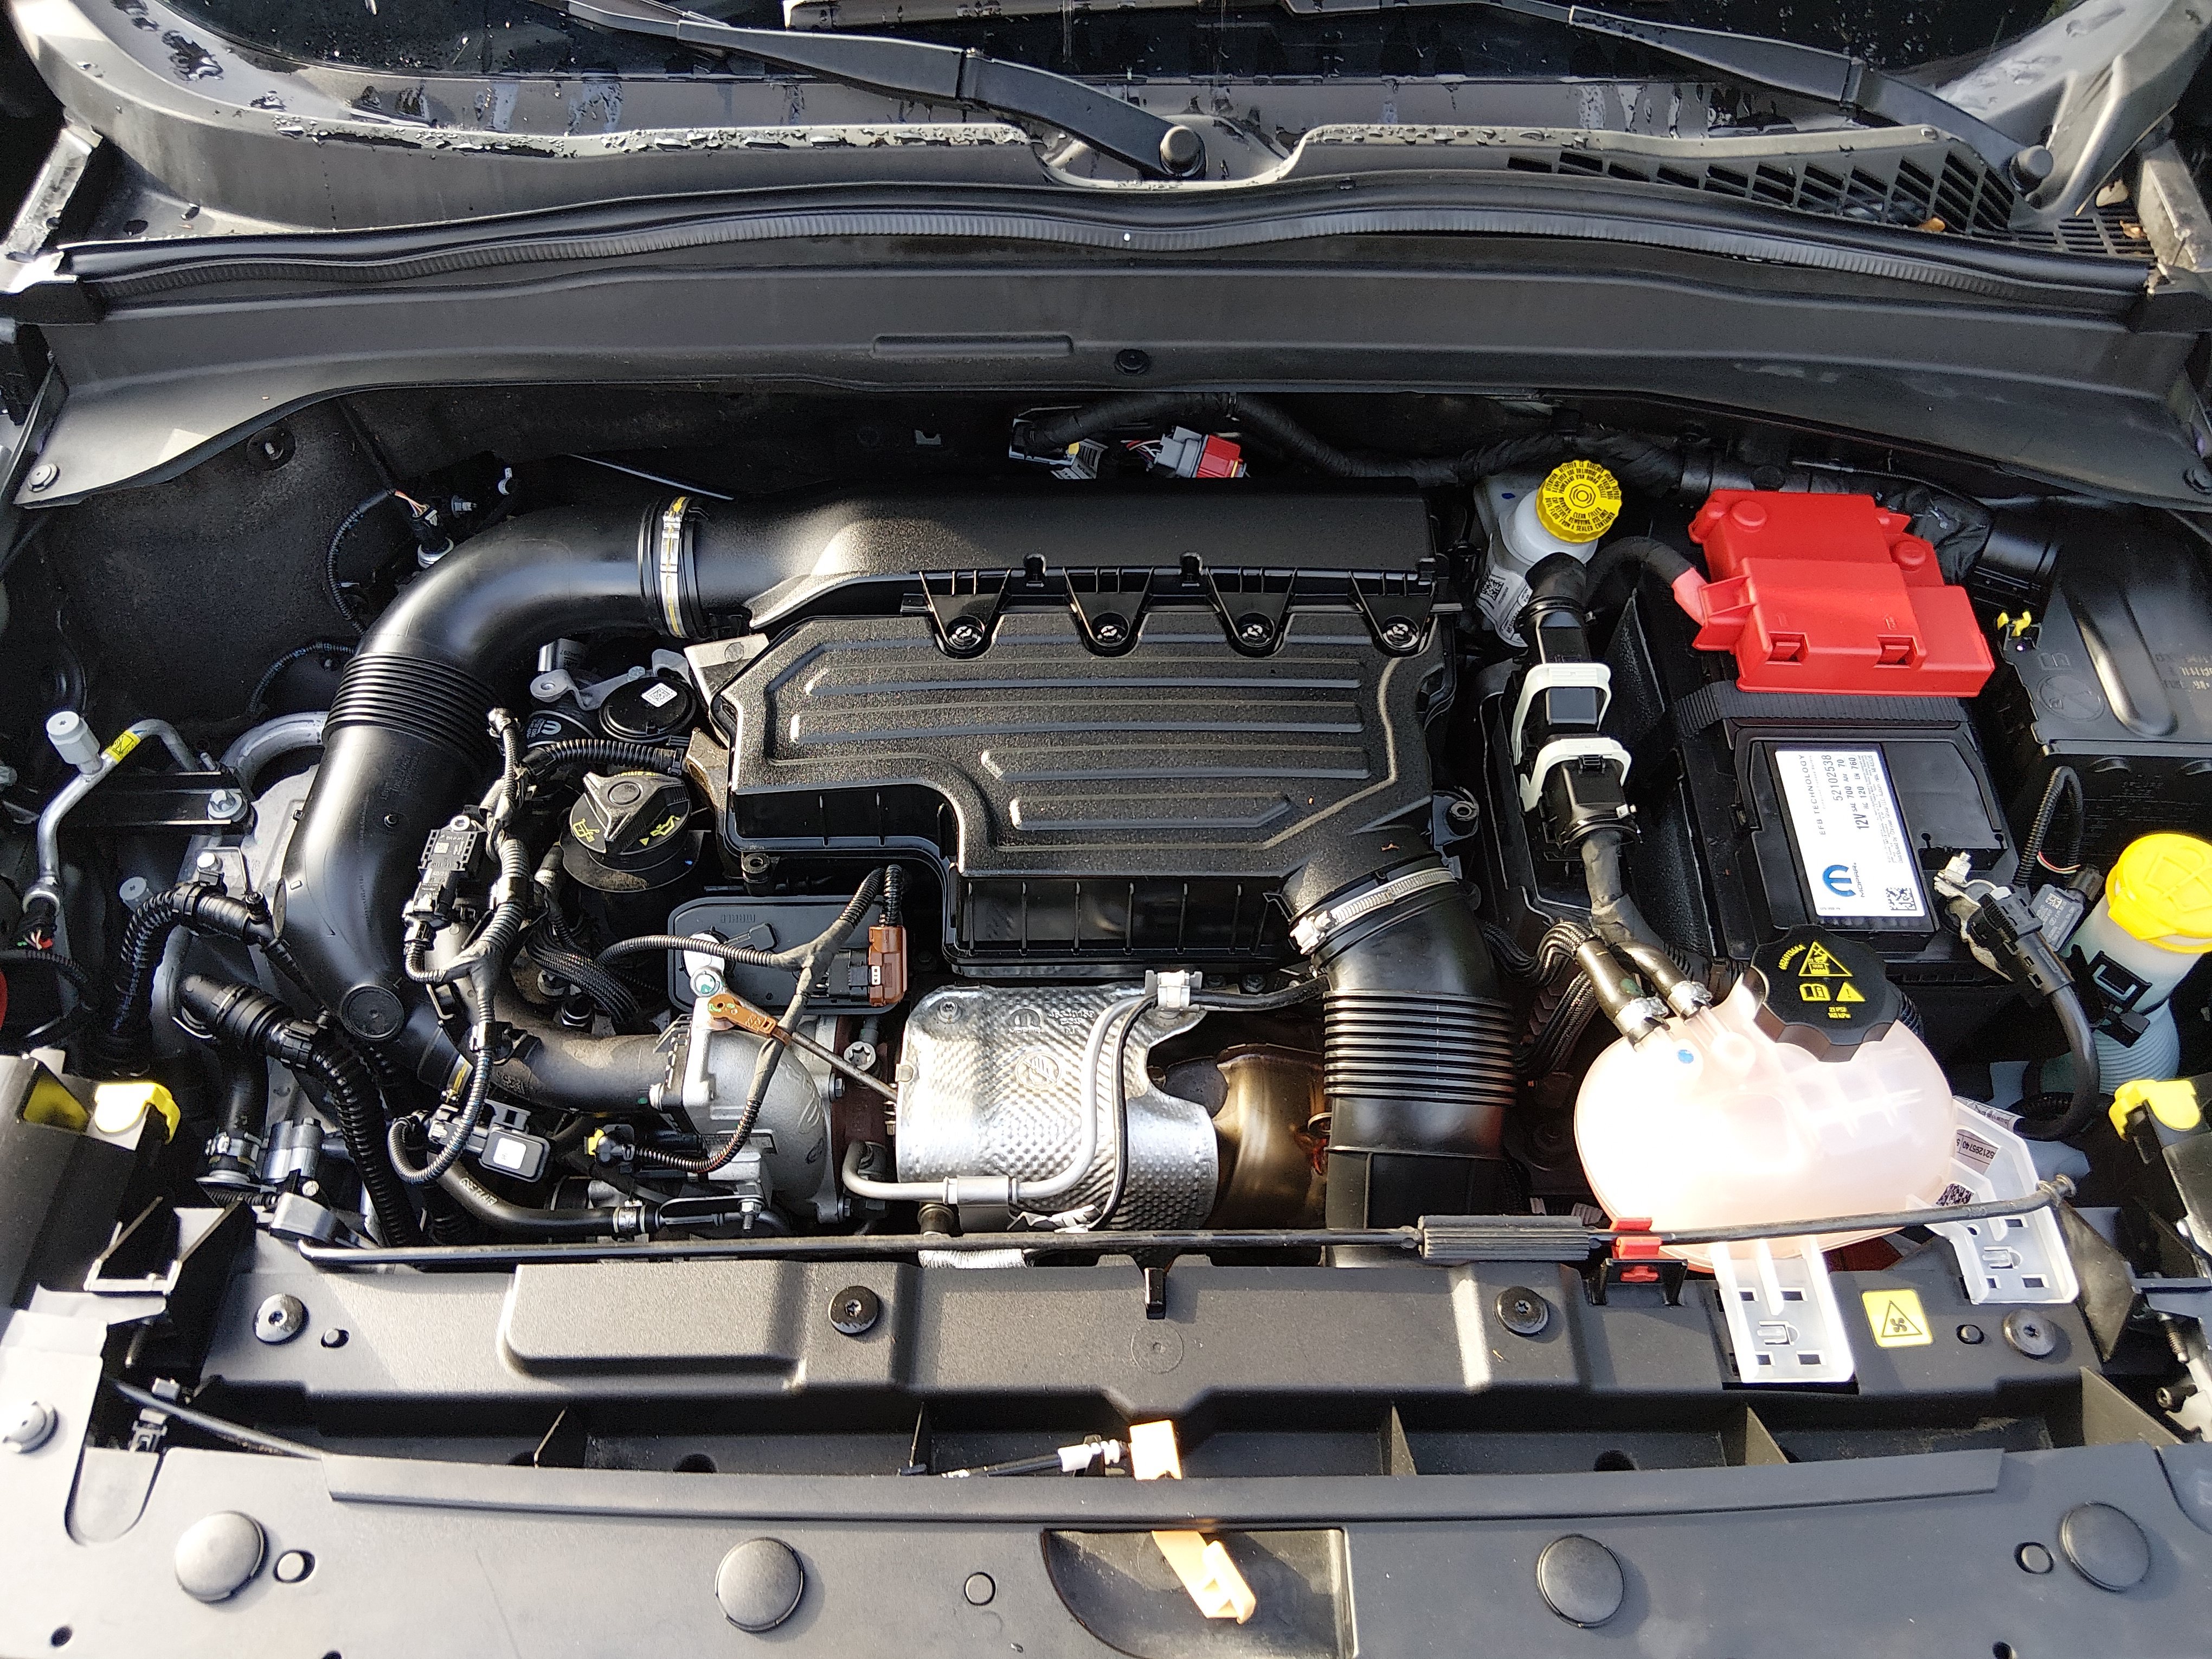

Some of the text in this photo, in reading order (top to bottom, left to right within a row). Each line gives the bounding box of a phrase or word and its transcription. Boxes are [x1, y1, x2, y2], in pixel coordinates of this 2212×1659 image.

[1559, 519, 1570, 528] FROM
[1836, 759, 1846, 767] 70
[1848, 757, 1859, 769] 760
[1821, 755, 1843, 801] 52102538
[1798, 754, 1826, 835] EFB TECHNOLOGY
[1843, 786, 1855, 799] 700
[1856, 786, 1867, 798] 120
[1852, 813, 1870, 829] 12V
[1851, 865, 1865, 897] MOPAR
